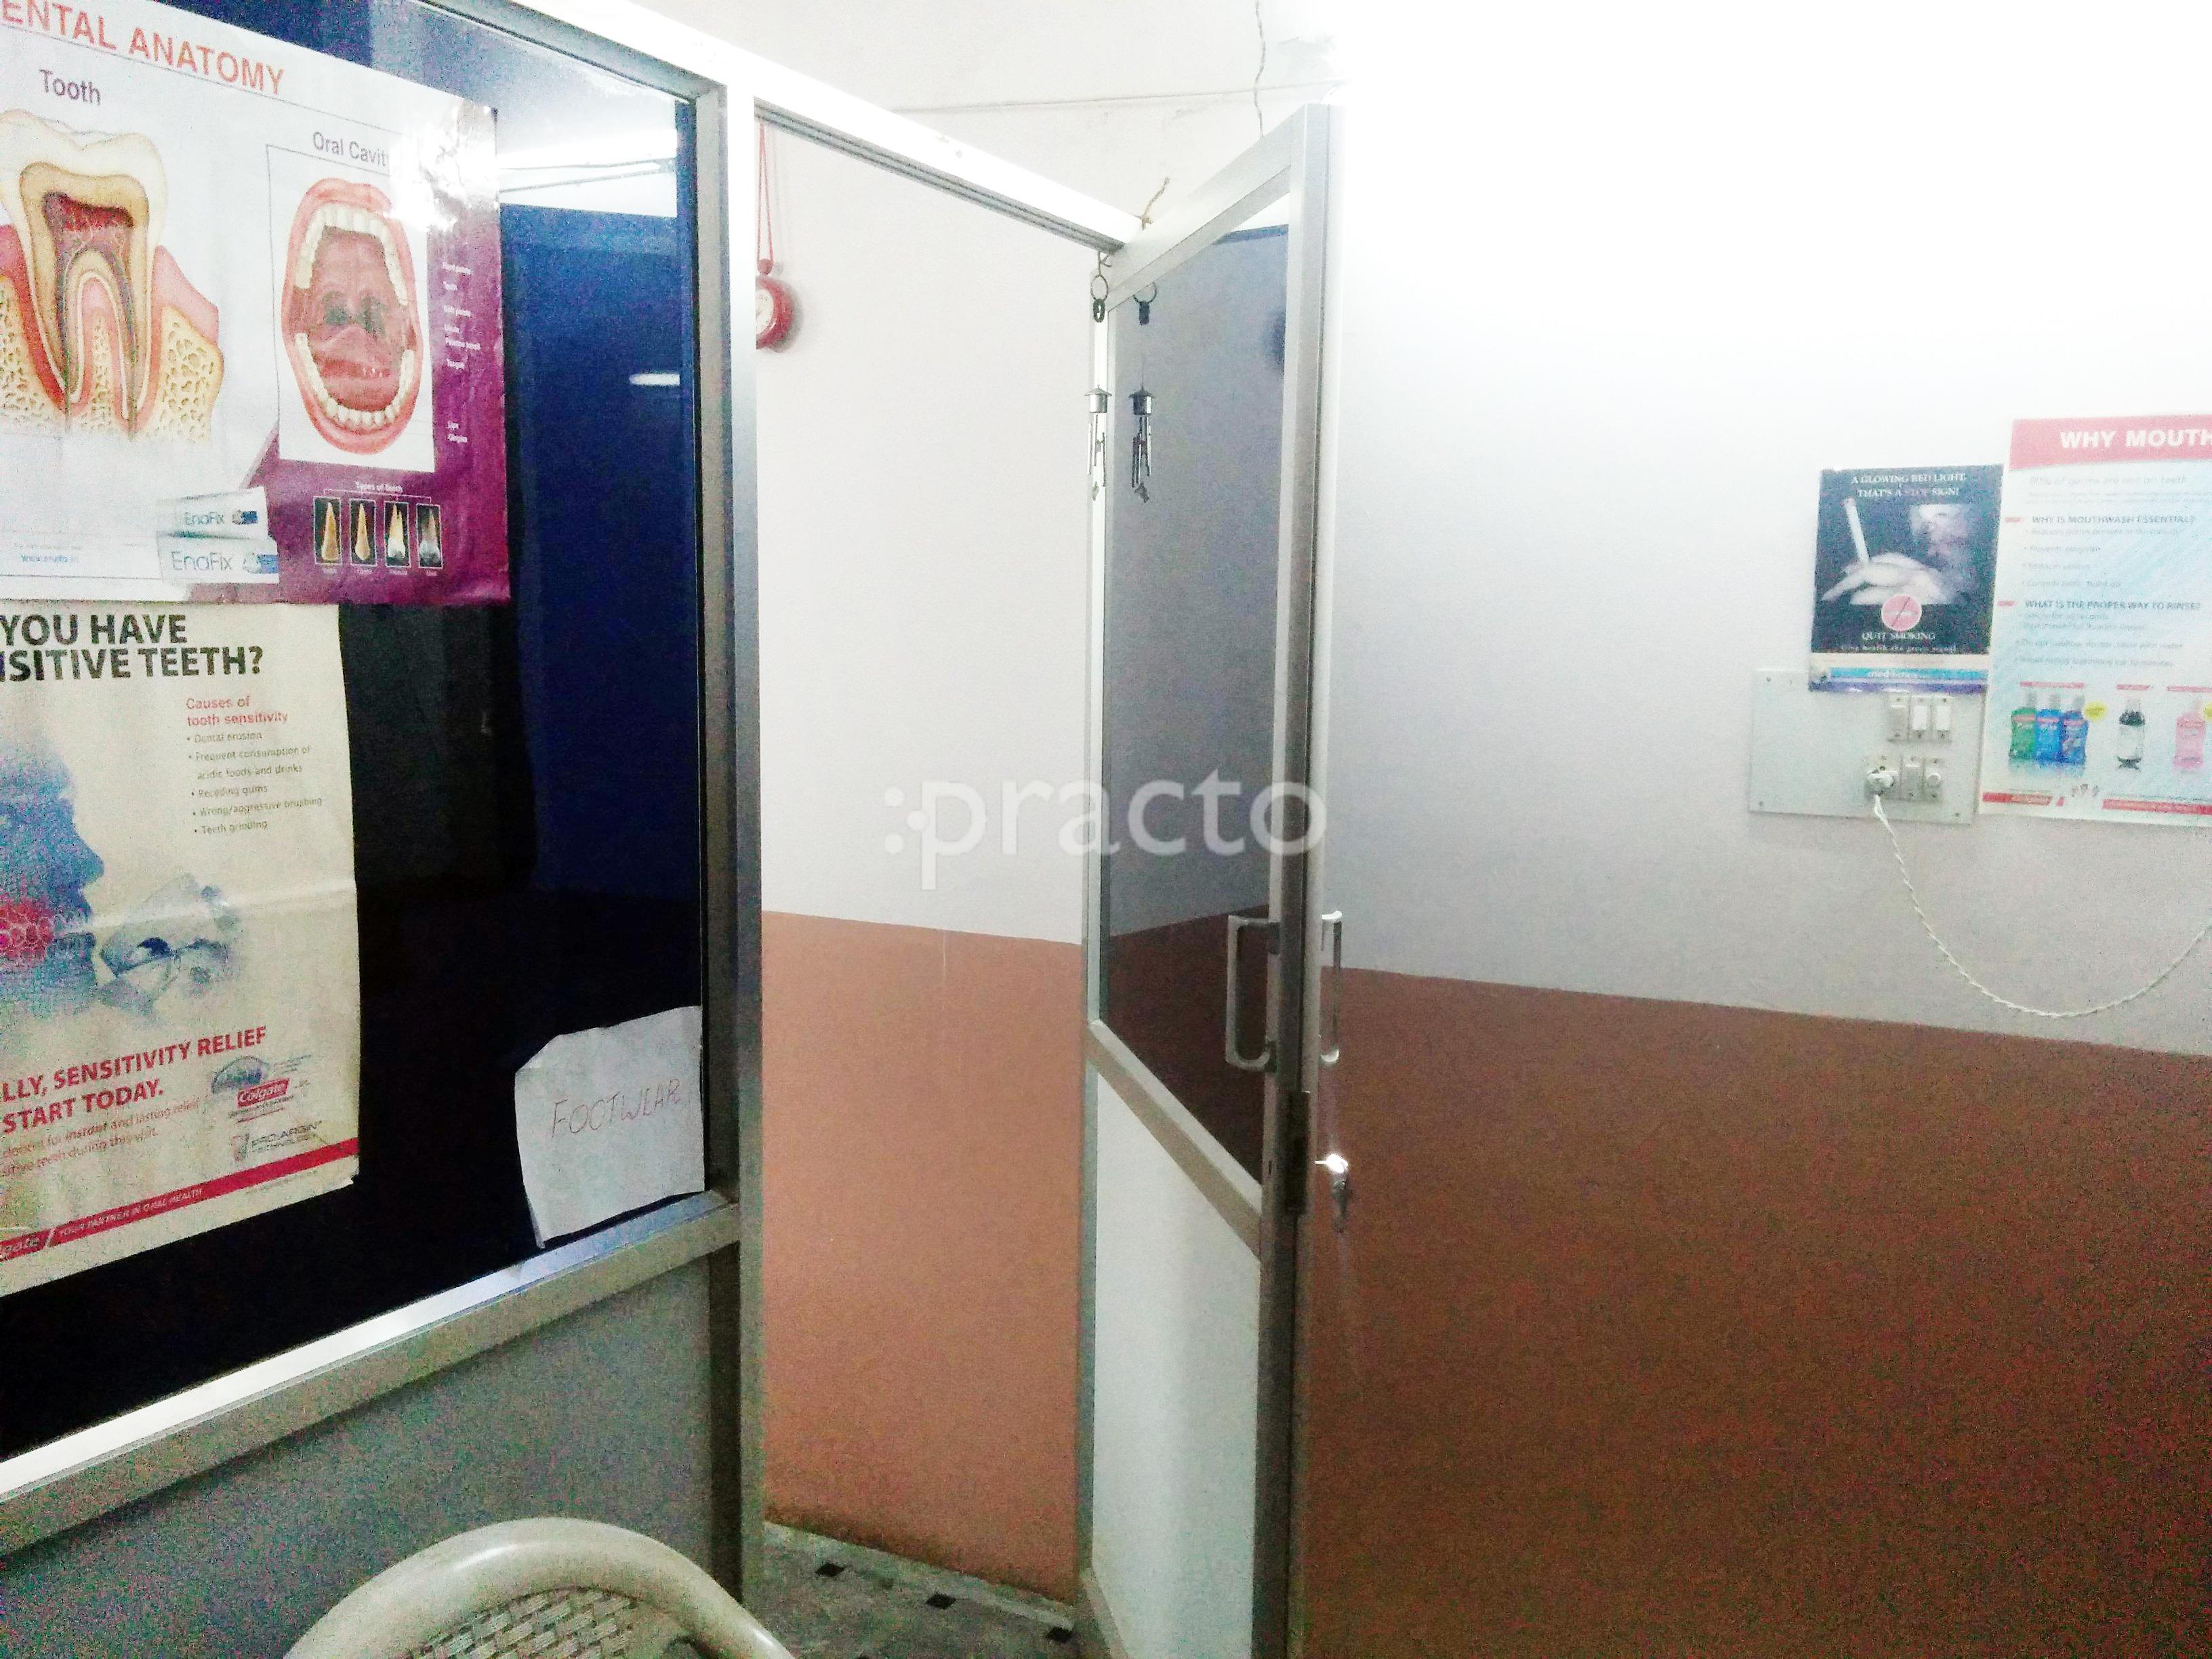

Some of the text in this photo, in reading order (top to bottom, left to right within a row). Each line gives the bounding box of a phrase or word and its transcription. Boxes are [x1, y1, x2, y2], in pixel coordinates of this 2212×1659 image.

[128, 27, 283, 95] ANATOMY
[39, 69, 101, 105] Tooth
[313, 131, 344, 155] Oral
[2060, 430, 2117, 448] WHY
[1861, 475, 1908, 483] GLOWING
[1911, 474, 1931, 483] RED
[1858, 489, 1891, 497] THAT'S
[1931, 487, 1959, 495] SIGN!
[2032, 516, 2054, 524] WHY
[2057, 516, 2066, 524] IS
[2068, 516, 2134, 525] MOUTHWASH
[2025, 600, 2053, 609] WHAT
[2087, 601, 2126, 609] PROPER
[2152, 602, 2164, 610] TO
[0, 614, 187, 647] YOU HAVE
[1862, 631, 1936, 641] QUIT SMOKING
[138, 645, 264, 677] TEETH?
[186, 695, 250, 710] Causes of
[187, 711, 288, 726] tooth sensitivity
[194, 732, 262, 743] Dental erosion
[196, 745, 310, 762] Frequent consumption of
[226, 766, 251, 777] foods
[255, 764, 271, 775] and
[274, 763, 303, 774] drinks
[198, 785, 268, 798] Receding gums
[284, 796, 323, 808] brushing
[201, 819, 268, 835] Teeth grinding
[54, 1042, 190, 1088] SENSITIVITY
[198, 1025, 267, 1057] RELIEF
[239, 1082, 287, 1105] Colgate
[3, 1079, 164, 1134] START TODAY.
[552, 1079, 680, 1138] FOOTWEAR
[110, 1115, 134, 1130] and
